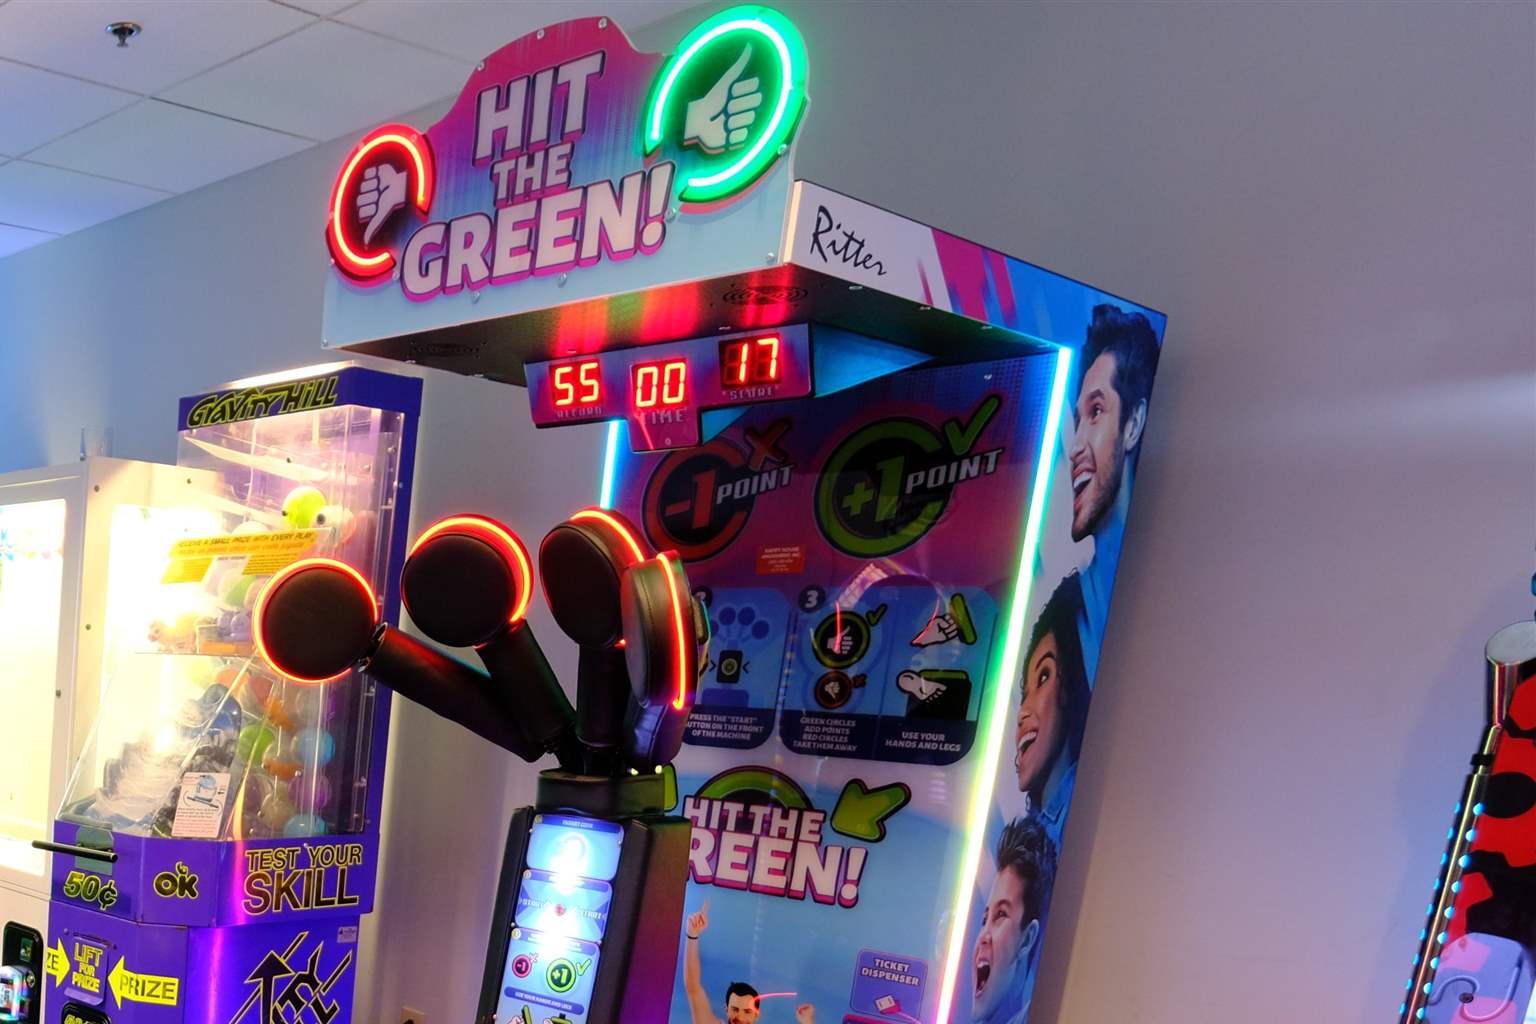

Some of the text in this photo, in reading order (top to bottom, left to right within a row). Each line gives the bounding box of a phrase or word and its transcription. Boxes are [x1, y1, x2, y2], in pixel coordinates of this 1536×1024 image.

[473, 50, 606, 166] HIT
[491, 141, 575, 208] THE
[400, 160, 675, 303] GREEN!
[810, 205, 887, 276] Ritter
[738, 337, 779, 382] 17
[555, 363, 599, 406] 55
[636, 362, 686, 407] 00
[716, 463, 796, 505] POINT
[905, 449, 1004, 495] POINT
[805, 590, 818, 608] 3
[739, 724, 764, 732] FRONT
[800, 717, 824, 725] GREEN
[822, 727, 850, 735] POINTS
[716, 731, 751, 740] MACHINE
[885, 739, 961, 752] HANDS AND LEGS
[901, 731, 945, 741] USE YOUR
[684, 795, 826, 843] HIT THE
[245, 844, 363, 871] TEST YOUR
[689, 827, 868, 907] REEN!
[64, 870, 118, 910] 50¢
[242, 866, 359, 916] SKILL
[74, 942, 103, 967] LIFT
[874, 958, 910, 973] TICKET
[72, 971, 101, 993] PRIZE
[79, 962, 95, 977] FOR
[861, 967, 919, 986] DISPENSER
[119, 974, 176, 1000] PRIZE
